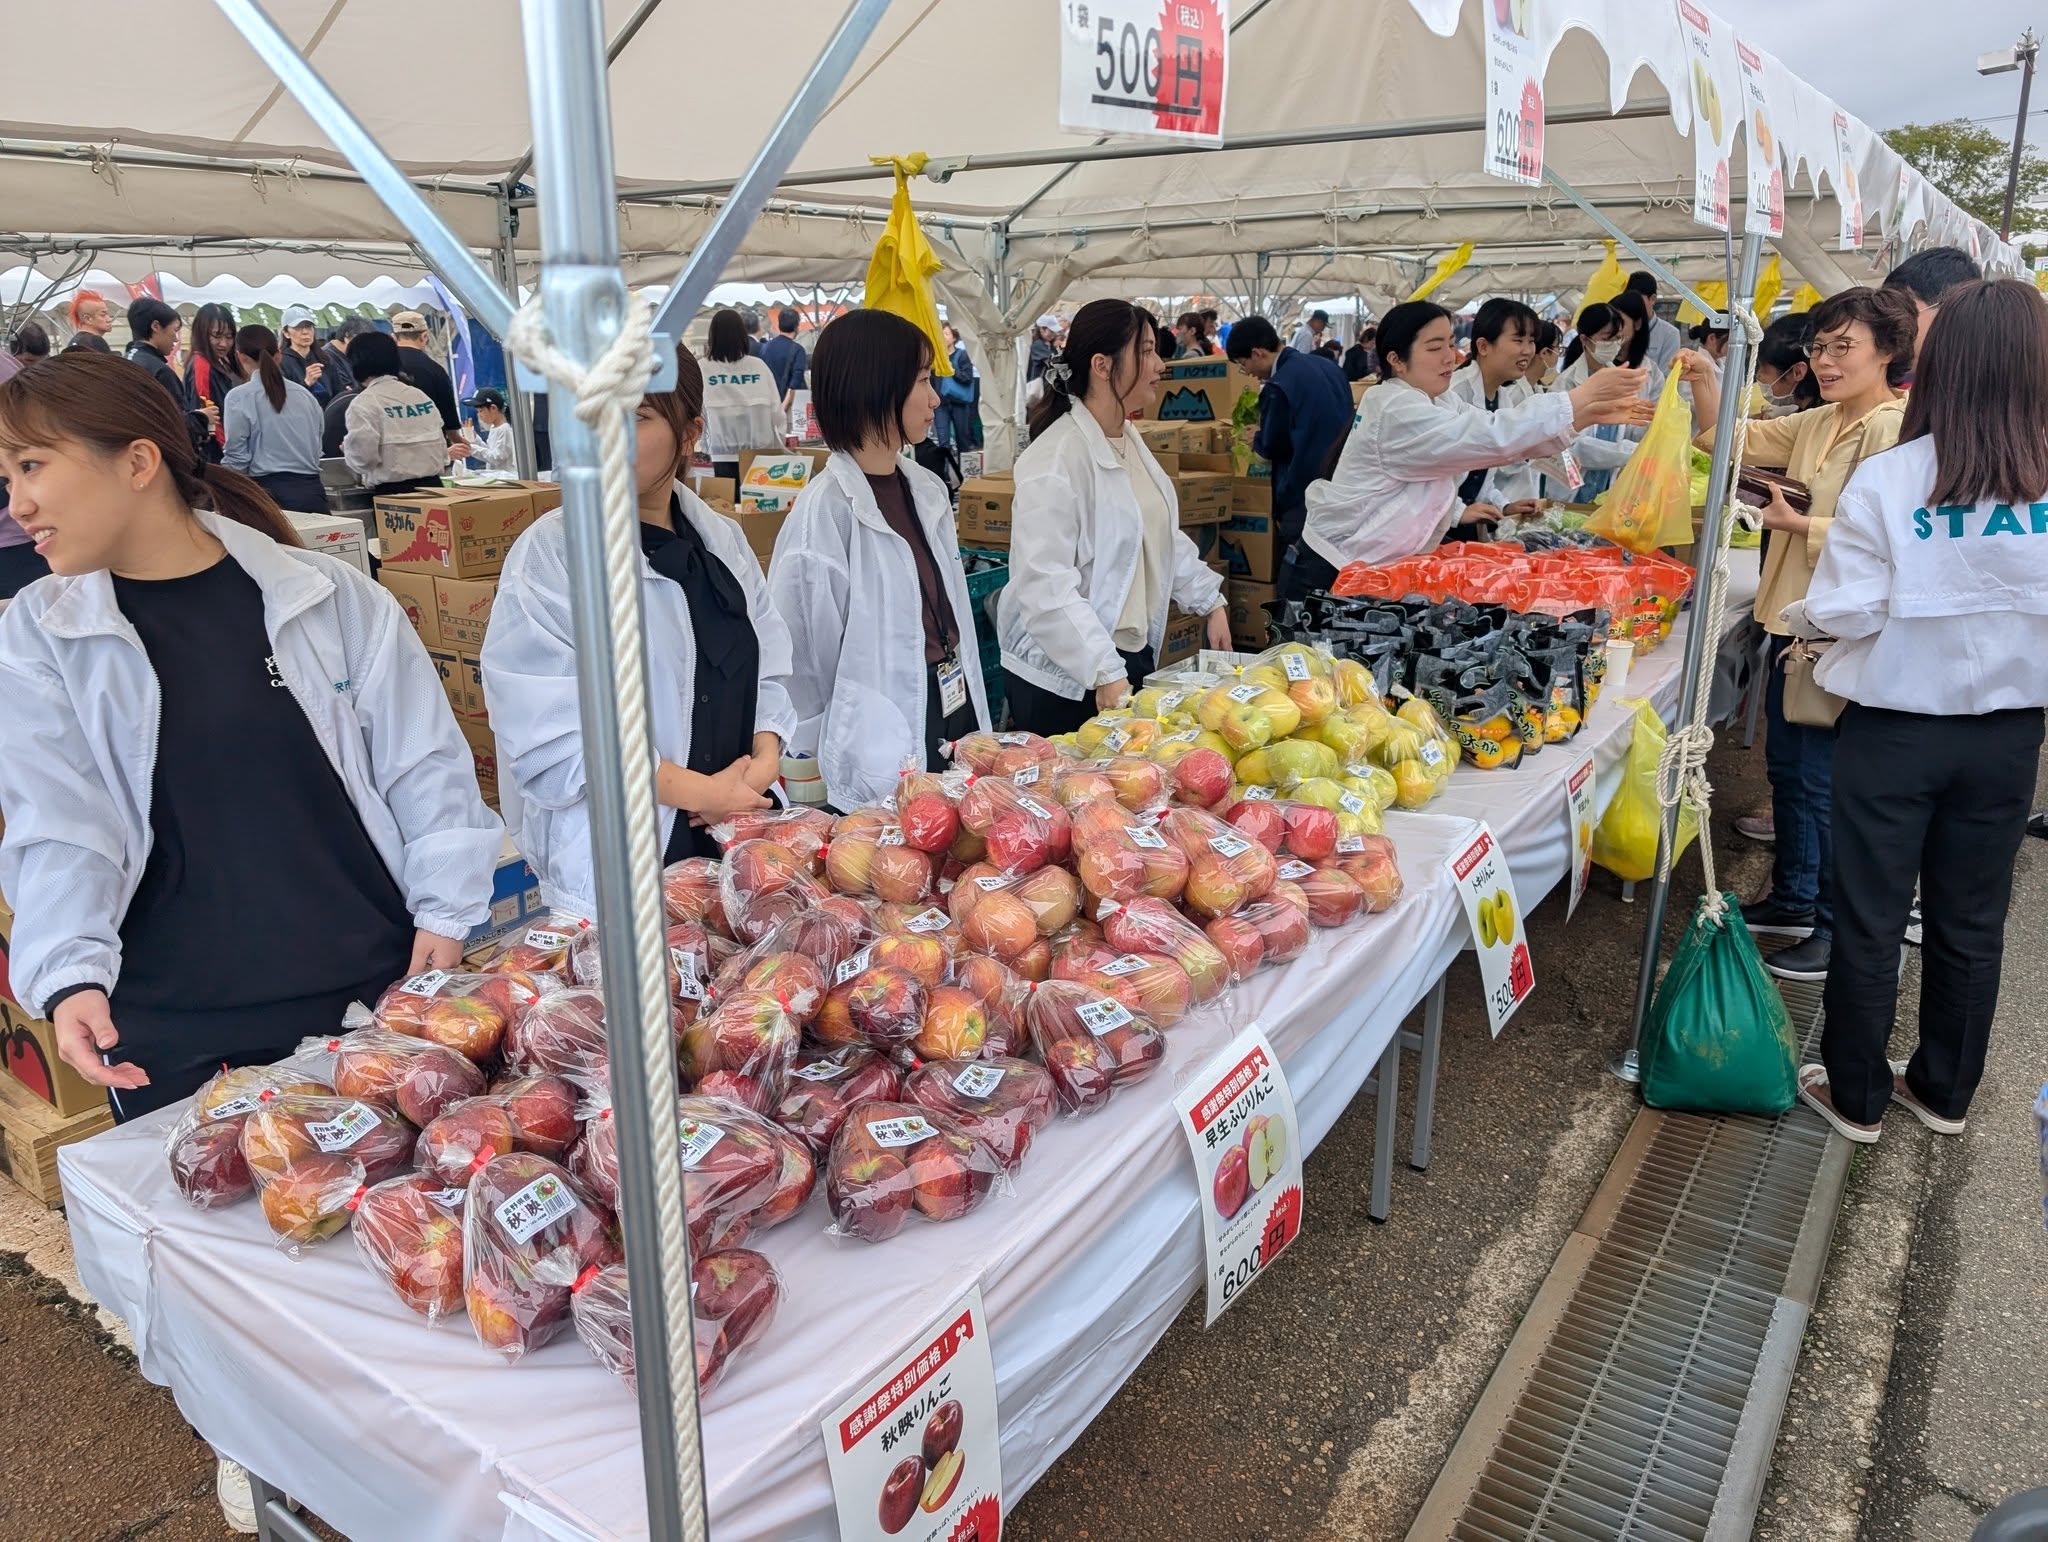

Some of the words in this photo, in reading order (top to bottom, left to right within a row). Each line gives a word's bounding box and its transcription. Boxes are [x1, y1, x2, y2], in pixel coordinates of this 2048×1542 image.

[708, 374, 761, 386] STAFF
[384, 401, 433, 418] STAFF
[1205, 1072, 1274, 1150] 早生ふじりんご
[875, 1128, 906, 1140] 秋映
[506, 1199, 543, 1230] 秋映
[881, 1372, 951, 1453] 秋映りんご
